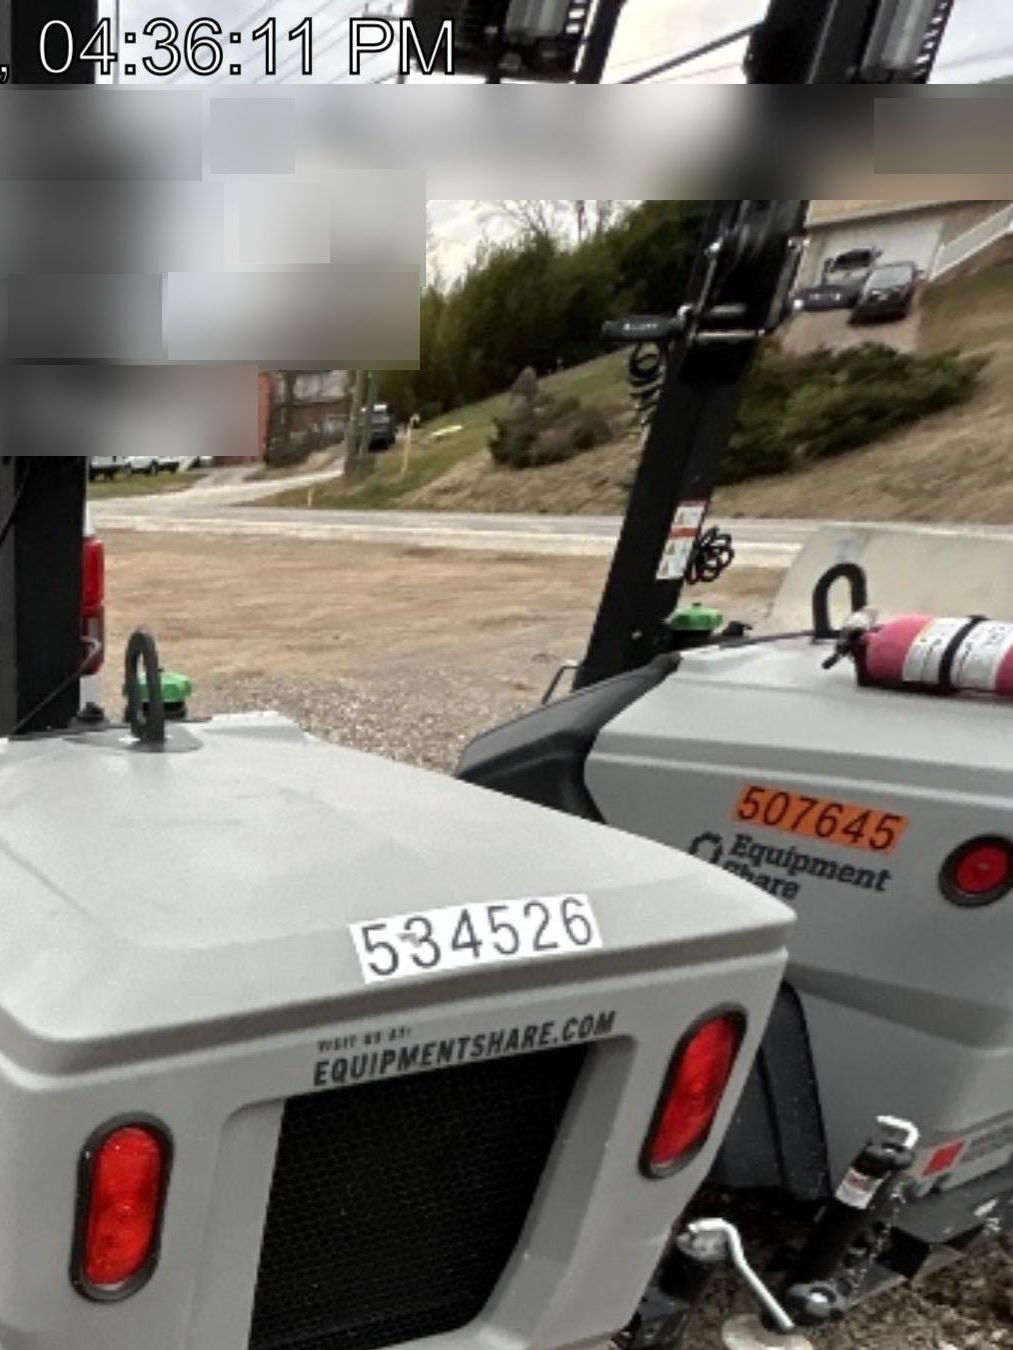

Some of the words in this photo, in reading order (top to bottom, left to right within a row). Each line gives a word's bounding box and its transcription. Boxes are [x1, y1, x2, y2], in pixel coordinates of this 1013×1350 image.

[738, 785, 902, 851] 507645
[728, 833, 892, 892] Equipment
[361, 897, 593, 976] 534526
[314, 1010, 617, 1086] EQUIPMENTSHARE.COM
